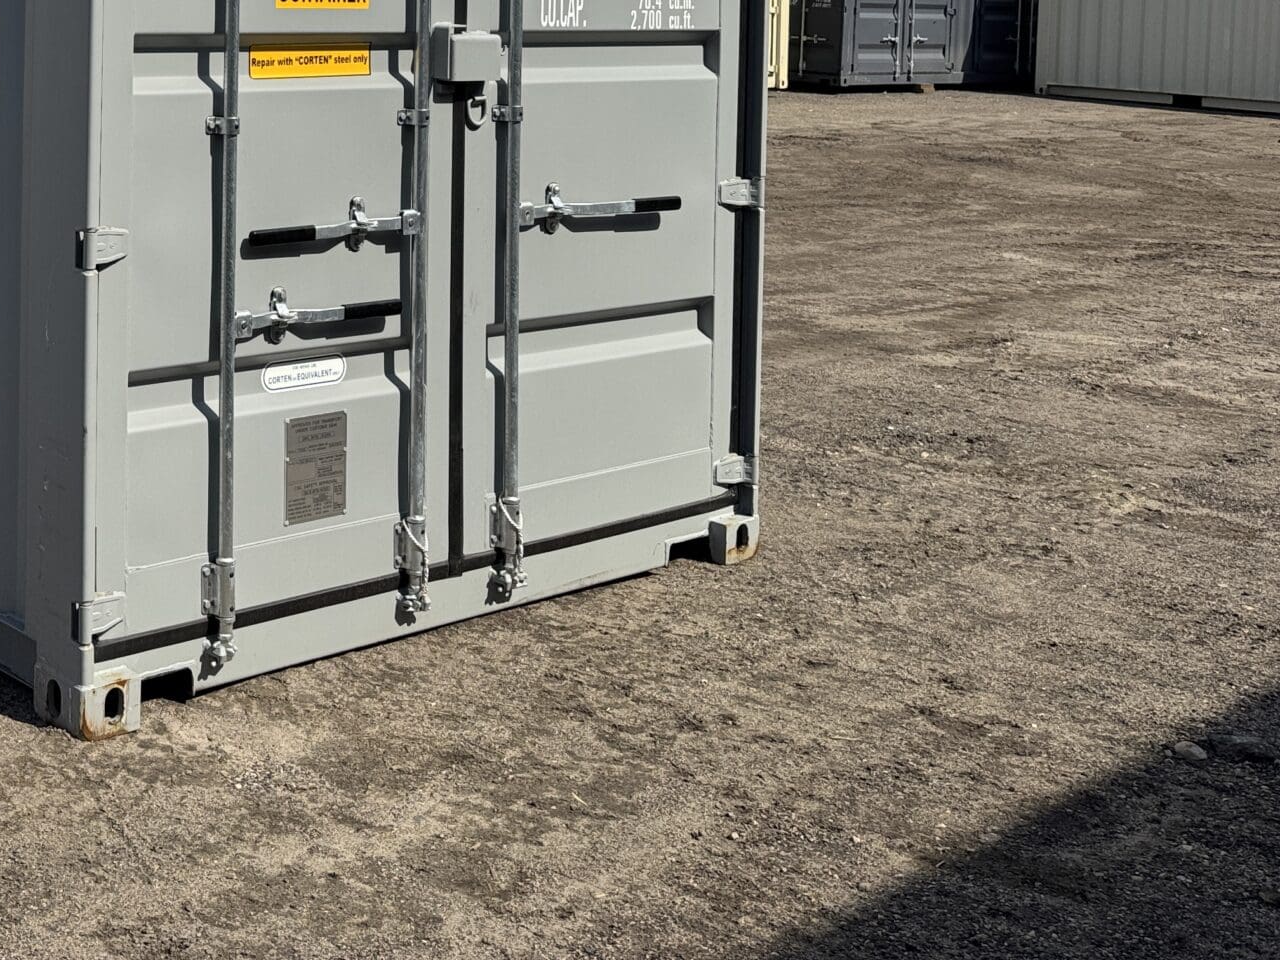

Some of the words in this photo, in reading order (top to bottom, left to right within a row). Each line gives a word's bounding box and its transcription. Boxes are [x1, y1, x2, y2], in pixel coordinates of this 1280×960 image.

[630, 10, 662, 30] 2,700
[252, 58, 275, 69] Repair
[278, 56, 294, 66] with
[334, 54, 352, 64] steel
[352, 54, 368, 65] only
[268, 375, 292, 384] CORTEN
[297, 368, 332, 380] EQUIVALENT
